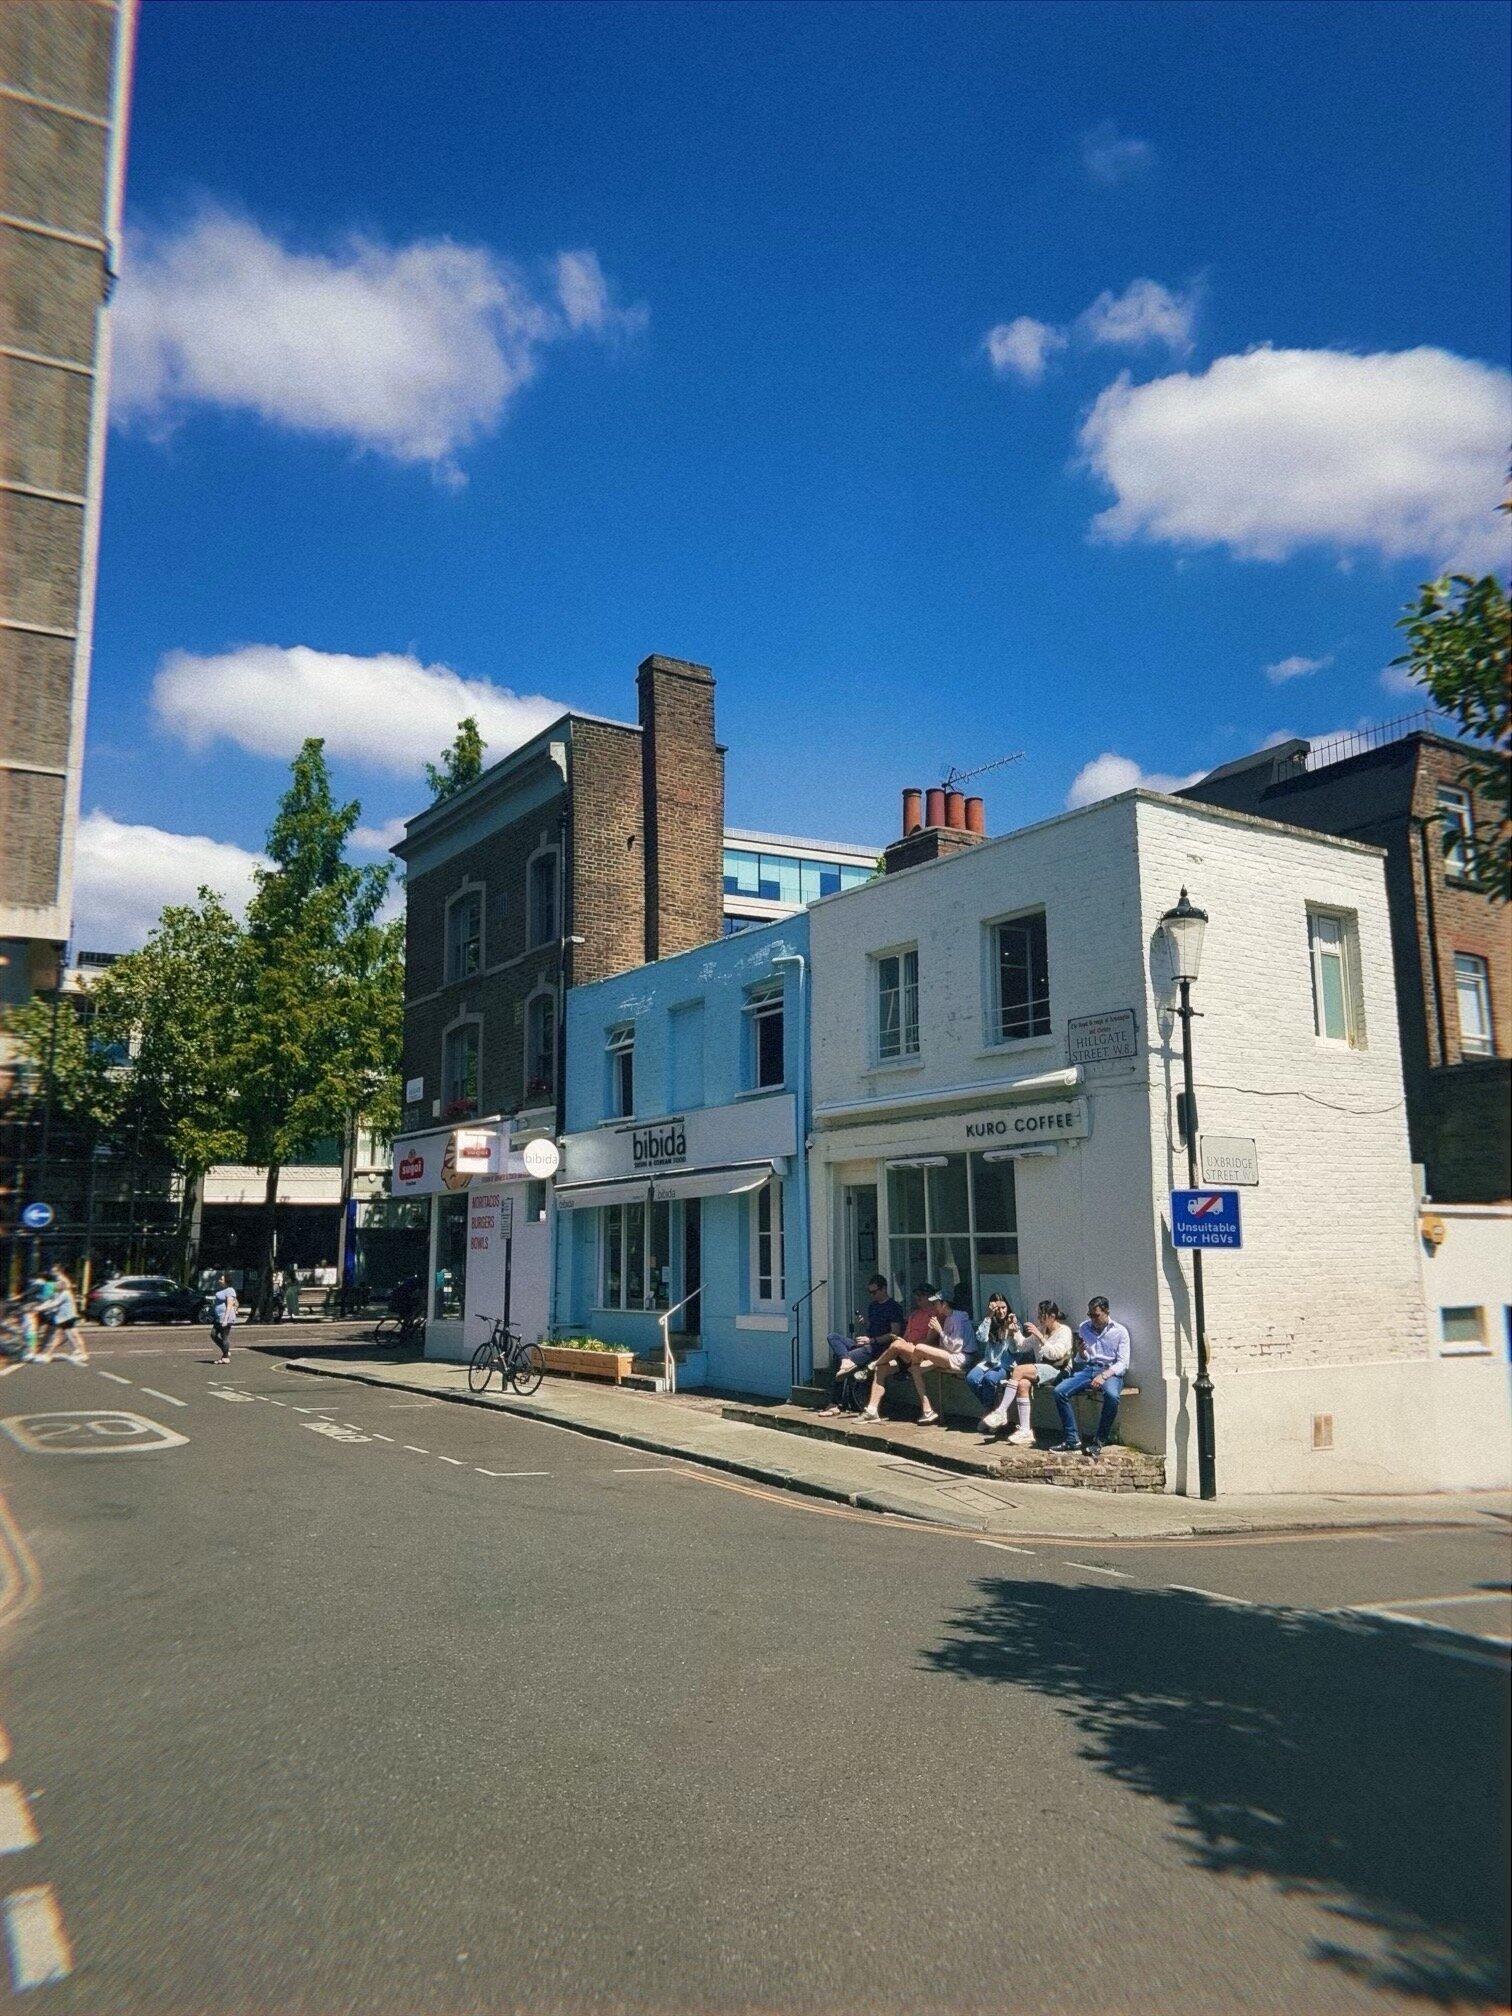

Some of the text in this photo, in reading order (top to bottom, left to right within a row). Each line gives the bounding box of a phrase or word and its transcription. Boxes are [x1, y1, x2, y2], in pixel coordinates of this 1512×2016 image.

[1076, 1031, 1127, 1048] HILLGATE
[966, 1113, 1073, 1137] KURO COFFEE
[632, 1126, 686, 1161] bibida
[526, 1153, 558, 1165] bibida
[1207, 1156, 1253, 1169] UXBRIDGE
[402, 1160, 422, 1176] sugoi
[472, 1195, 500, 1209] NORITACOS
[471, 1216, 494, 1229] BURGERS
[1177, 1222, 1236, 1233] Unsuitable
[471, 1236, 488, 1250] BOWLS
[1182, 1234, 1233, 1244] for HGVs
[28, 1419, 149, 1439] 20
